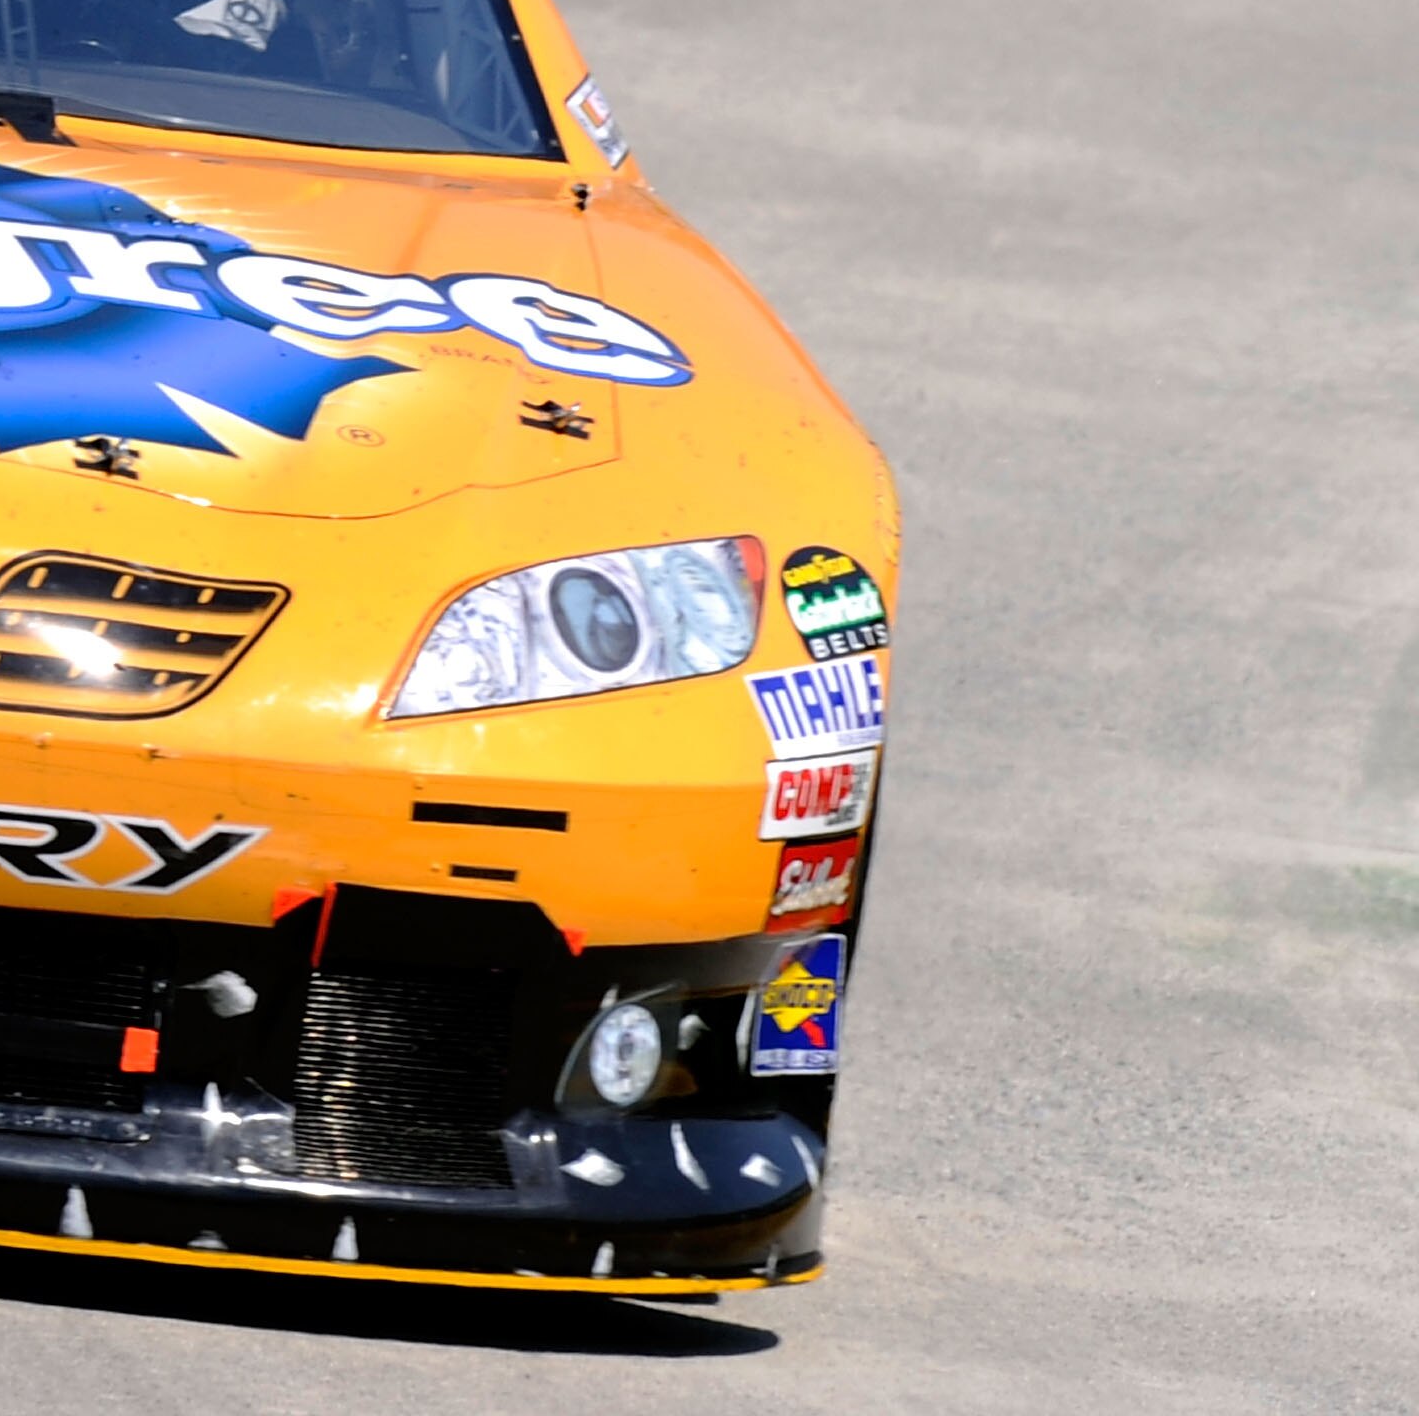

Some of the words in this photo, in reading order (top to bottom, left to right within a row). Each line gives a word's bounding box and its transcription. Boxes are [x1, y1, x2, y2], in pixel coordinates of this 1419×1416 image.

[809, 623, 889, 659] BELTS
[751, 659, 884, 741] MAHLE
[772, 763, 853, 821] COMP
